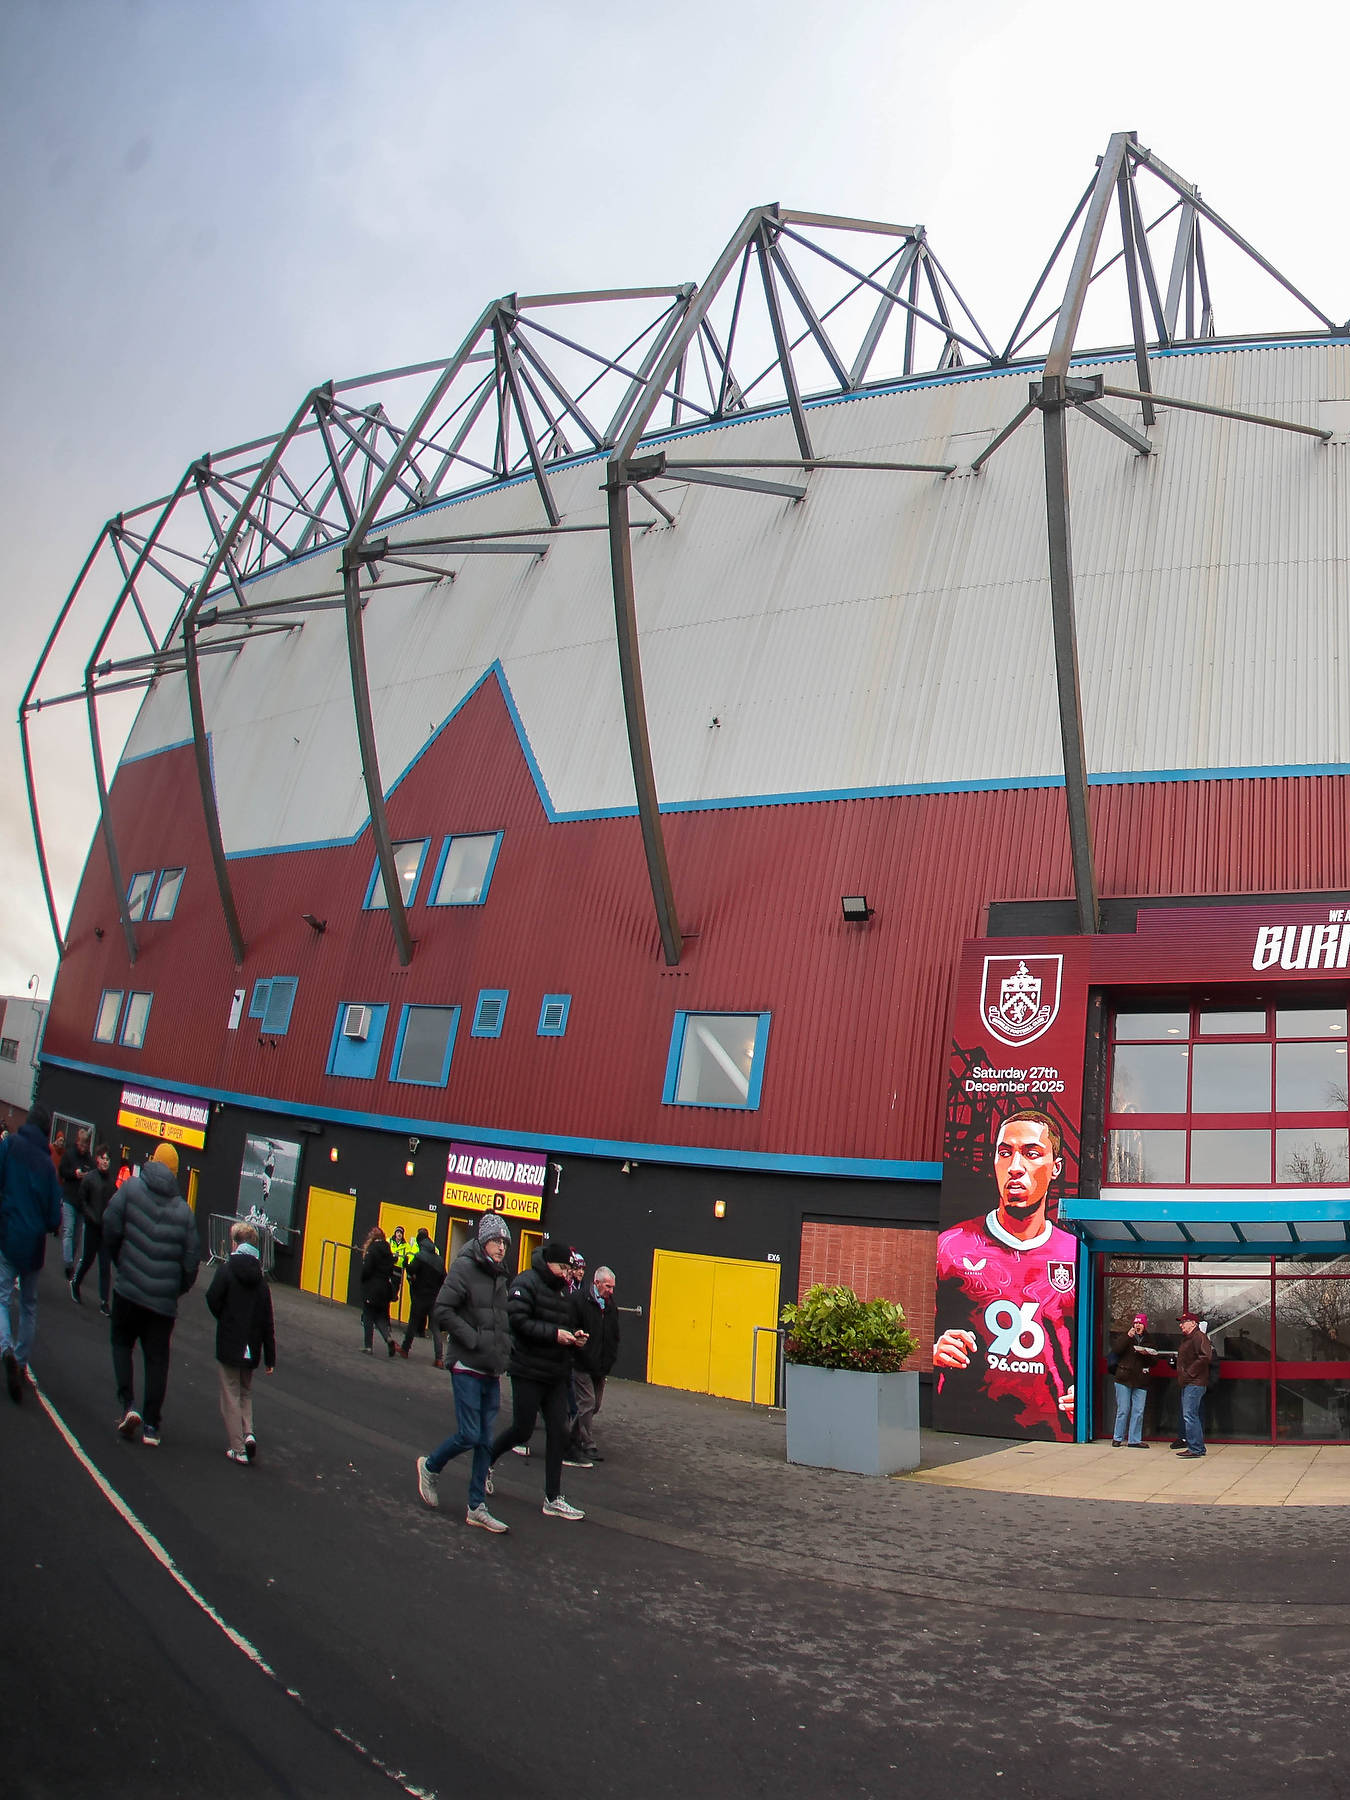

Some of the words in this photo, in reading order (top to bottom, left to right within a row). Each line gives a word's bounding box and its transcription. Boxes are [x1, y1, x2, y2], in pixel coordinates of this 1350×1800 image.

[1329, 909, 1344, 922] WE
[972, 1066, 1028, 1081] Saturday
[1030, 1067, 1058, 1079] 27th
[966, 1080, 1030, 1092] December
[1032, 1080, 1065, 1092] 2025
[456, 1156, 474, 1175] ALL
[473, 1158, 515, 1181] GROUND
[446, 1188, 493, 1206] ENTRANCE
[506, 1198, 539, 1214] LOWER
[768, 1254, 780, 1262] EX6
[984, 1300, 1045, 1358] 96
[987, 1354, 1045, 1374] 96.com
